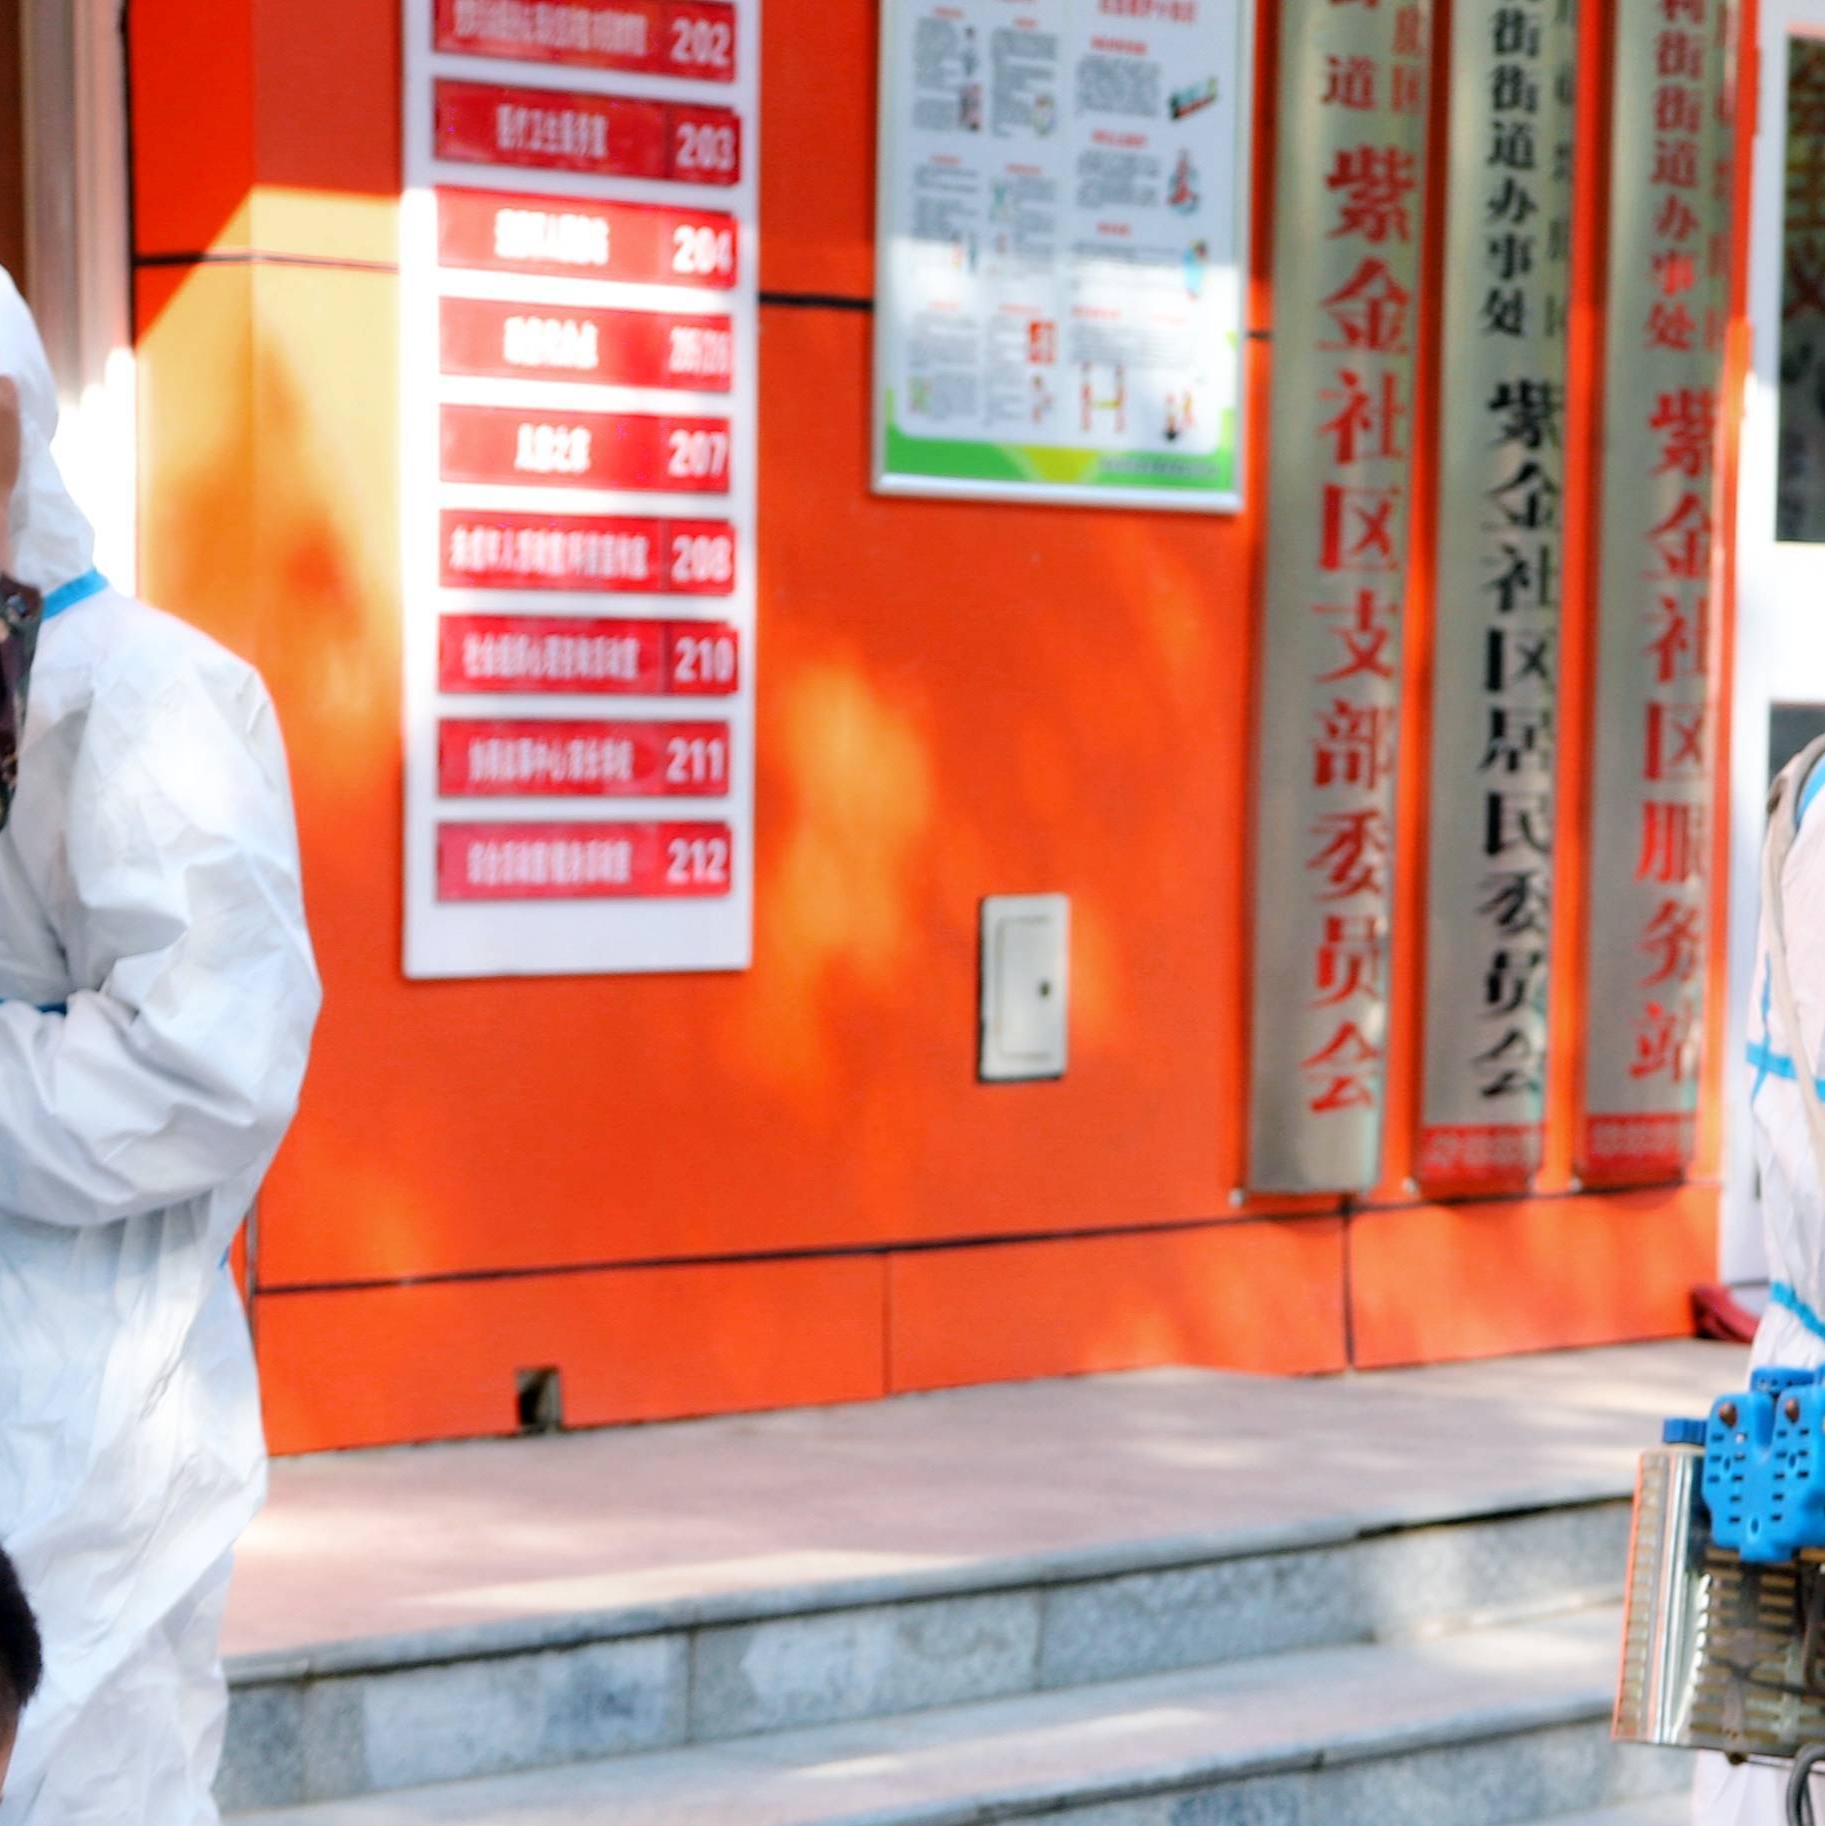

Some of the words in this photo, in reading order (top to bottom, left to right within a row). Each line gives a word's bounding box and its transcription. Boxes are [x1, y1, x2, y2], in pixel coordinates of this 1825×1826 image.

[1482, 0, 1540, 338] 街街道办事处
[668, 428, 729, 478] 207
[674, 636, 736, 684] 210
[1298, 143, 1415, 1116] 紫金社区支部委员会
[666, 736, 724, 783] 211
[1468, 374, 1564, 1103] 紫金社区居民委员会
[1629, 388, 1715, 1086] 紫金社区服务站
[666, 837, 726, 885] 212
